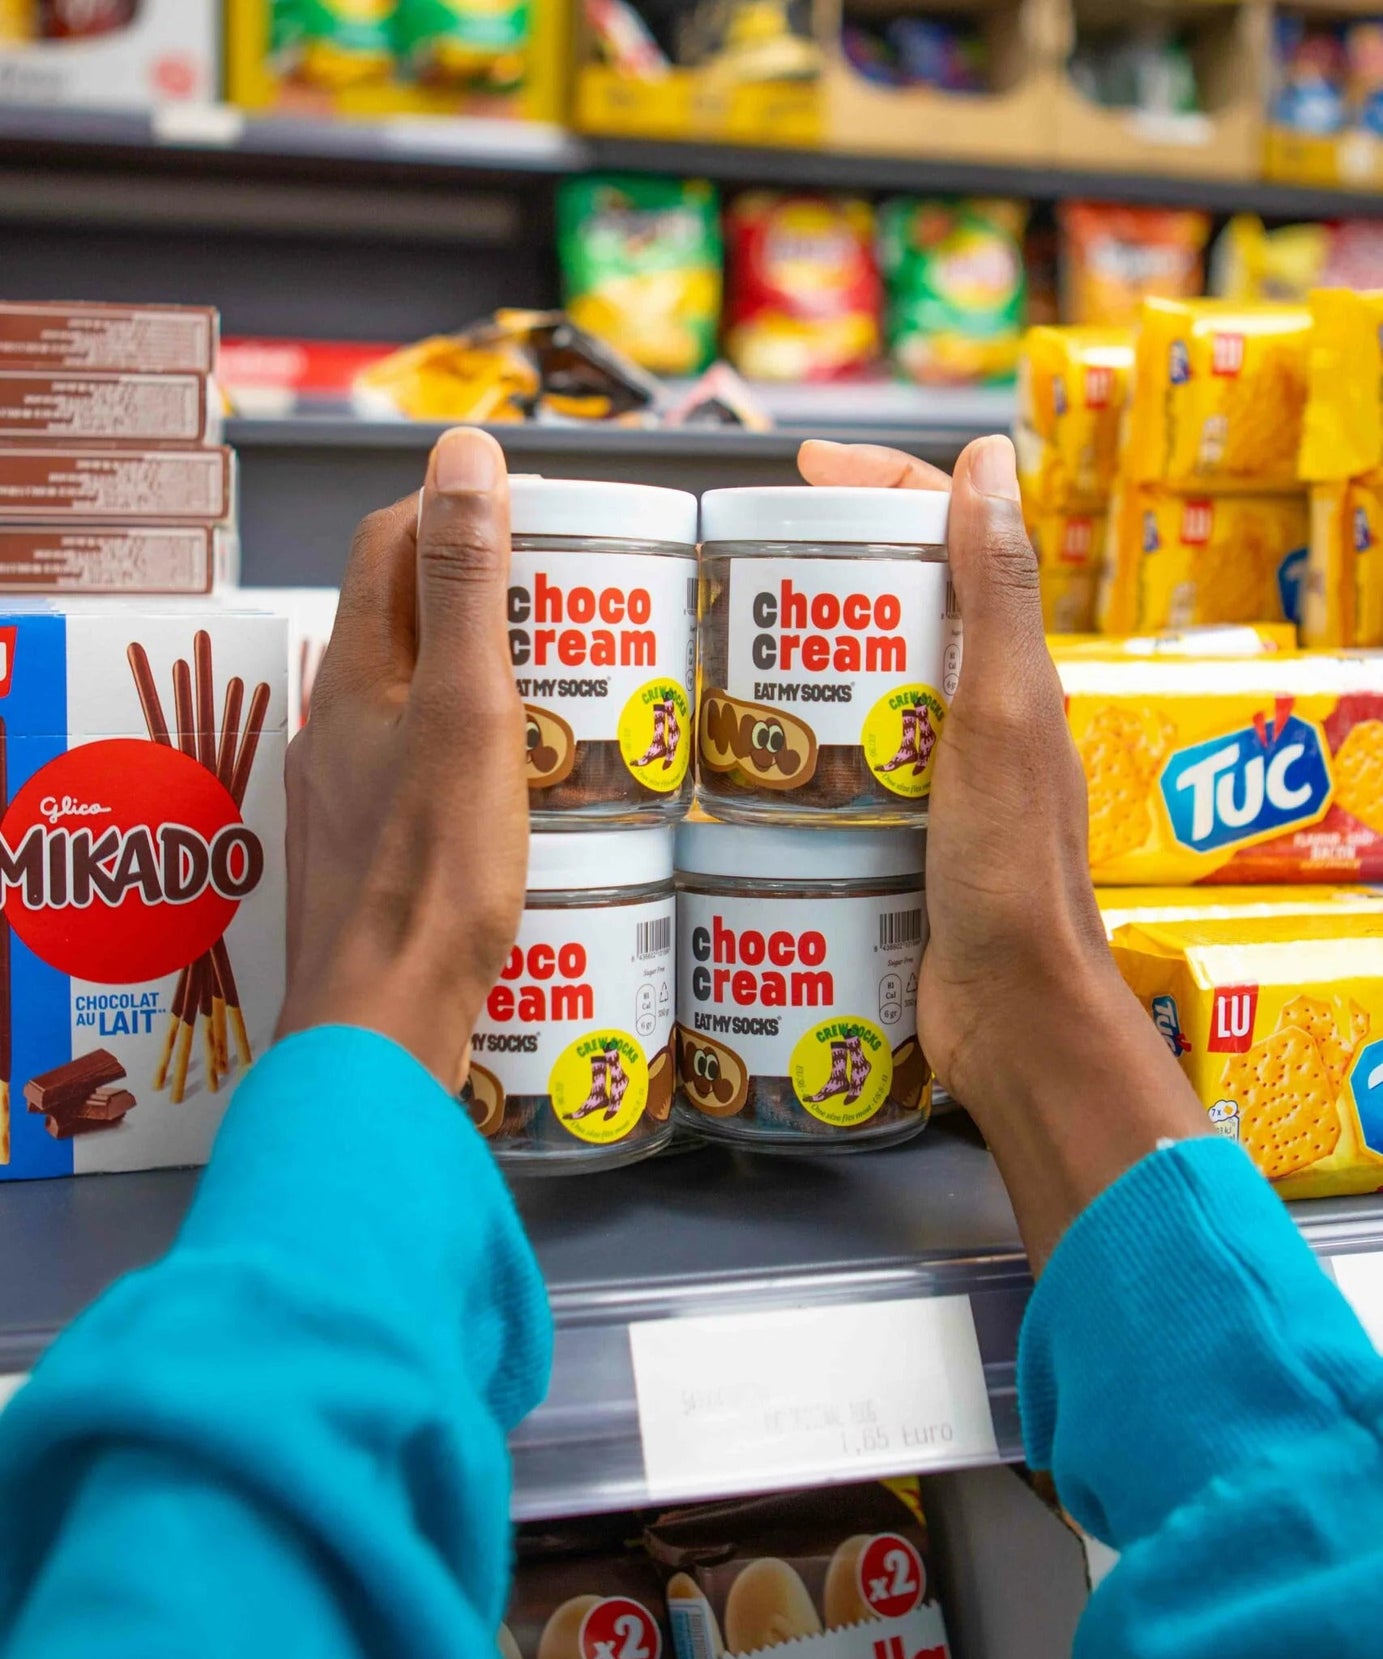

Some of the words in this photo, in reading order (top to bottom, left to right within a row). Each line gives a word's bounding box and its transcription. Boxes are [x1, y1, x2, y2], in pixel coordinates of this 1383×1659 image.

[507, 572, 651, 625] choco
[752, 579, 901, 631] choco
[508, 628, 656, 667] cream
[752, 633, 907, 672] cream
[533, 679, 557, 697] MY
[558, 679, 608, 698] SOCKS
[754, 682, 777, 701] EAT
[778, 682, 800, 702] MY
[801, 683, 853, 703] SOCKS
[40, 795, 112, 824] Glico
[1175, 742, 1313, 842] TUC
[0, 822, 264, 909] MIKADO
[692, 915, 827, 966] choco
[500, 942, 587, 981] oco
[75, 992, 160, 1011] CHOCOLAT
[486, 984, 594, 1022] eam
[692, 966, 834, 1006] cream
[76, 1012, 96, 1026] AU
[694, 1012, 712, 1030] EAT
[713, 1015, 733, 1033] MY
[732, 1016, 779, 1036] SOCKS
[815, 1023, 848, 1043] CREW
[1217, 994, 1251, 1038] LU
[487, 1034, 538, 1052] SOCKS
[869, 1548, 917, 1602] x2
[593, 1614, 650, 1659] x2
